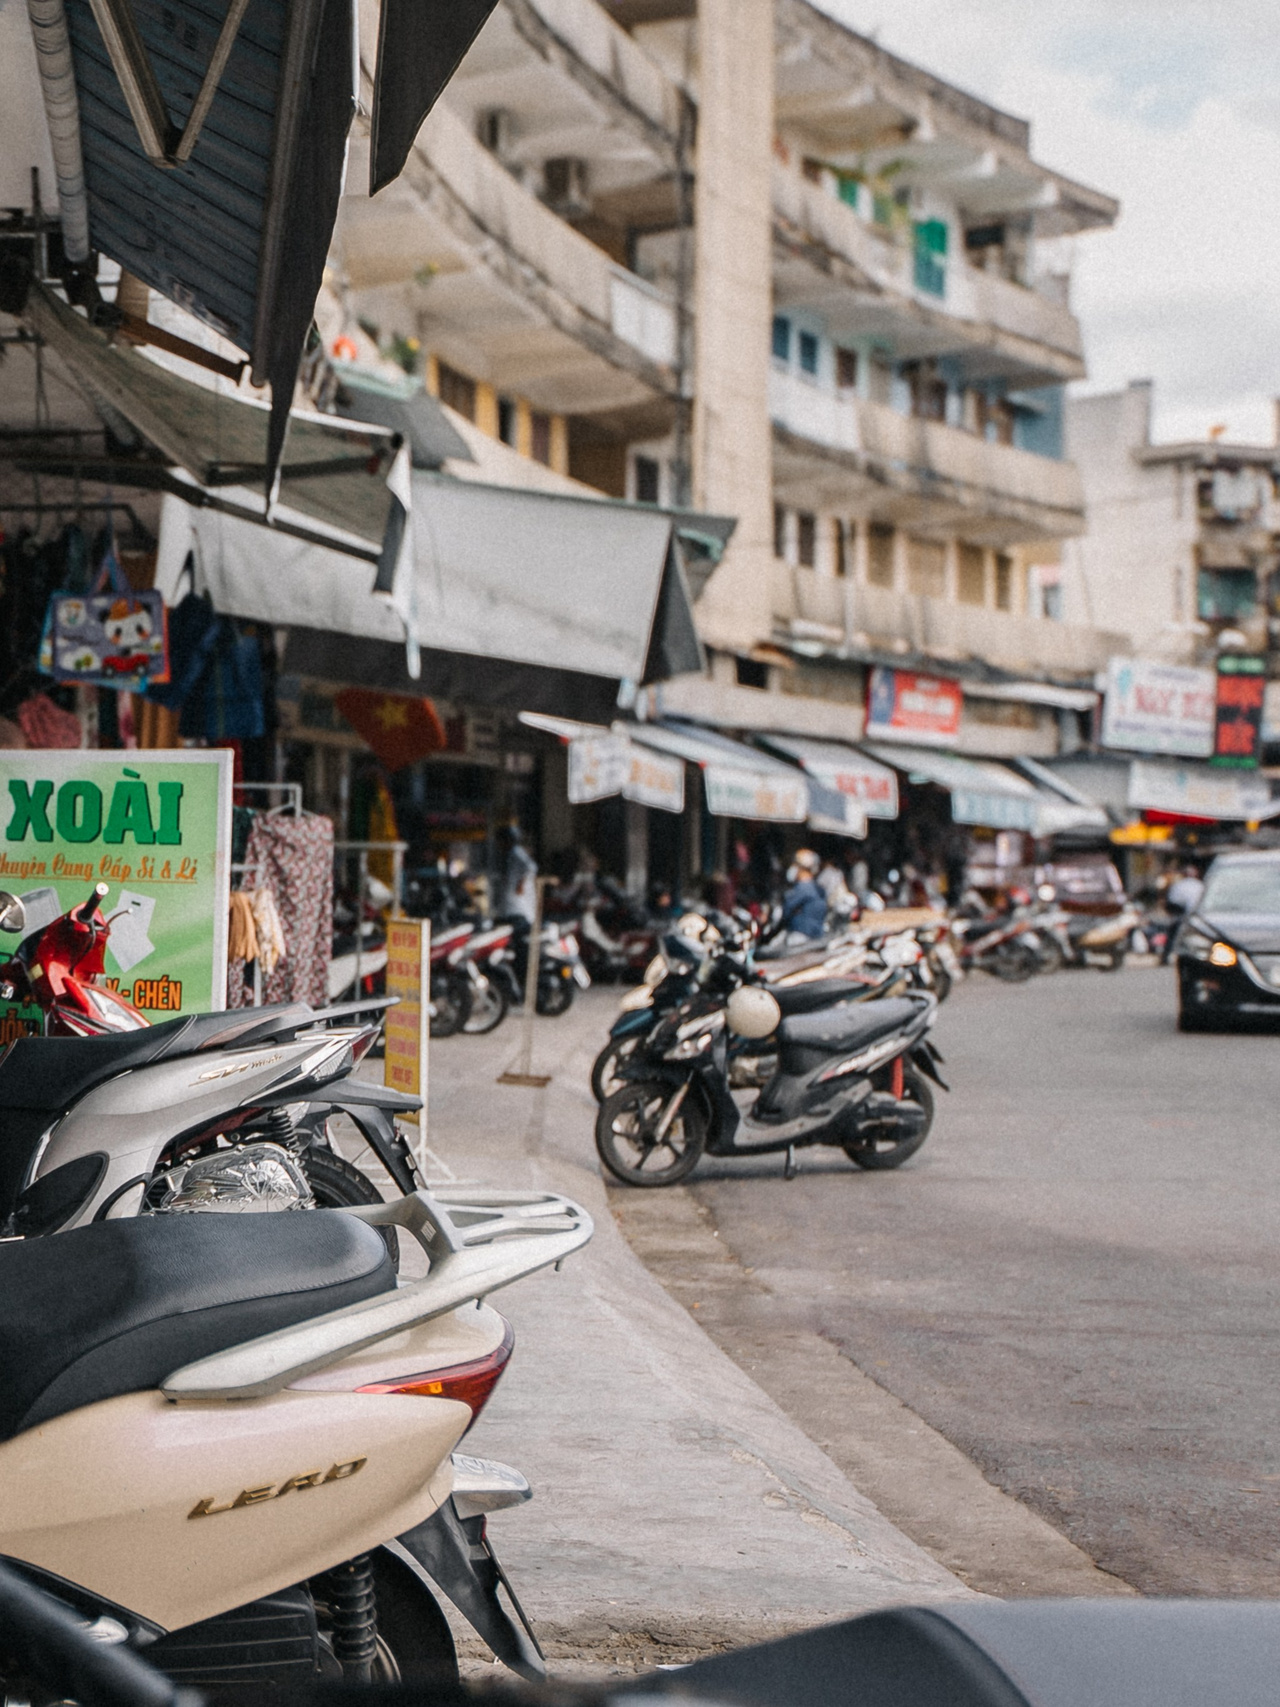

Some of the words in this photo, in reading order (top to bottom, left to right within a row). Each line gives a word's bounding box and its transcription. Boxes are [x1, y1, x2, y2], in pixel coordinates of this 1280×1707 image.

[5, 767, 183, 845] XOÀI
[52, 852, 94, 883] Cung
[160, 859, 171, 879] &
[133, 974, 183, 1012] CHÉN
[187, 1454, 368, 1520] LEAD
